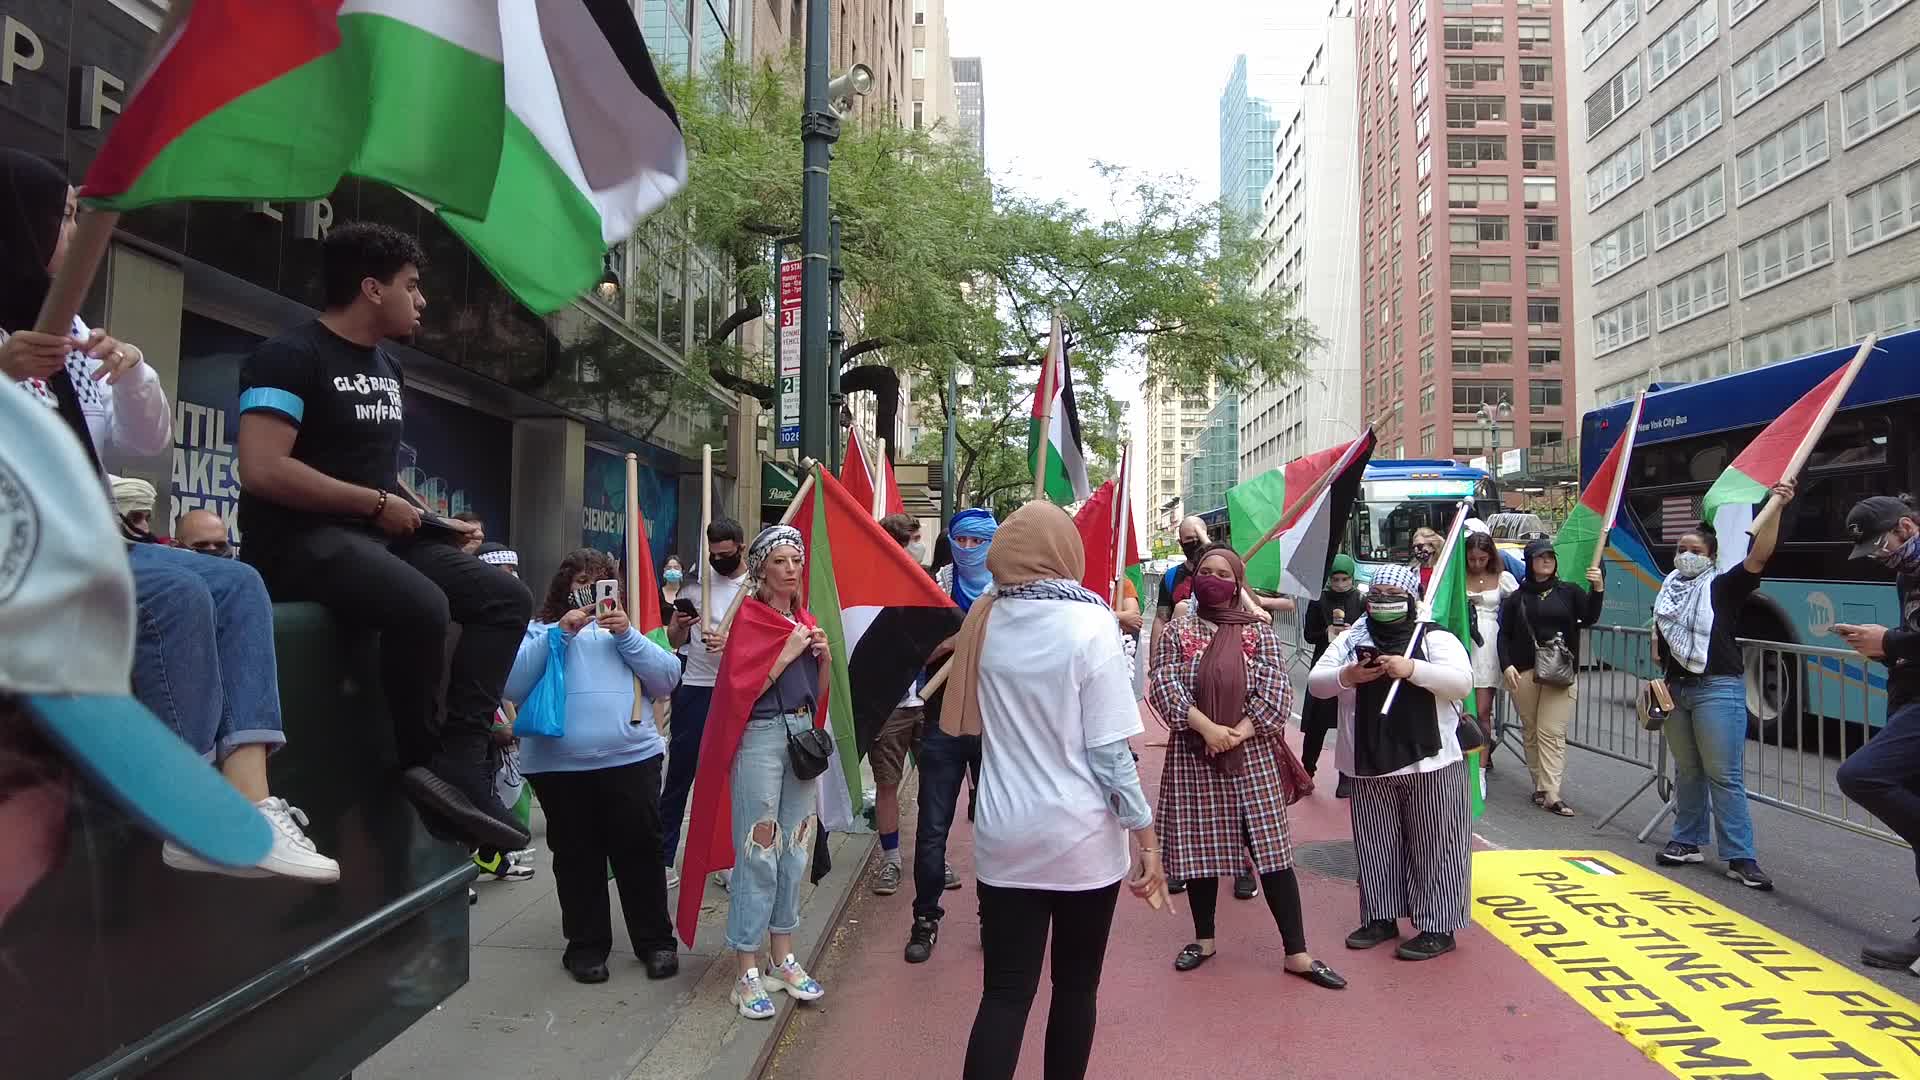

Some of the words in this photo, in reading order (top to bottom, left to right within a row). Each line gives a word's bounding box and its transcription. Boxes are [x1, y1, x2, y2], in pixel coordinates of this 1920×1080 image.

[782, 264, 790, 273] NO
[784, 311, 791, 326] 3
[784, 378, 791, 393] 2
[1638, 423, 1650, 432] New
[1651, 419, 1663, 430] York
[1663, 417, 1675, 428] City
[1676, 415, 1688, 425] Bus
[1517, 871, 1755, 992] PALESTINE
[1628, 890, 1716, 917] WE
[1688, 921, 1824, 982] WILL
[1476, 895, 1568, 938] OUR
[1533, 941, 1775, 1080] LIFETIM
